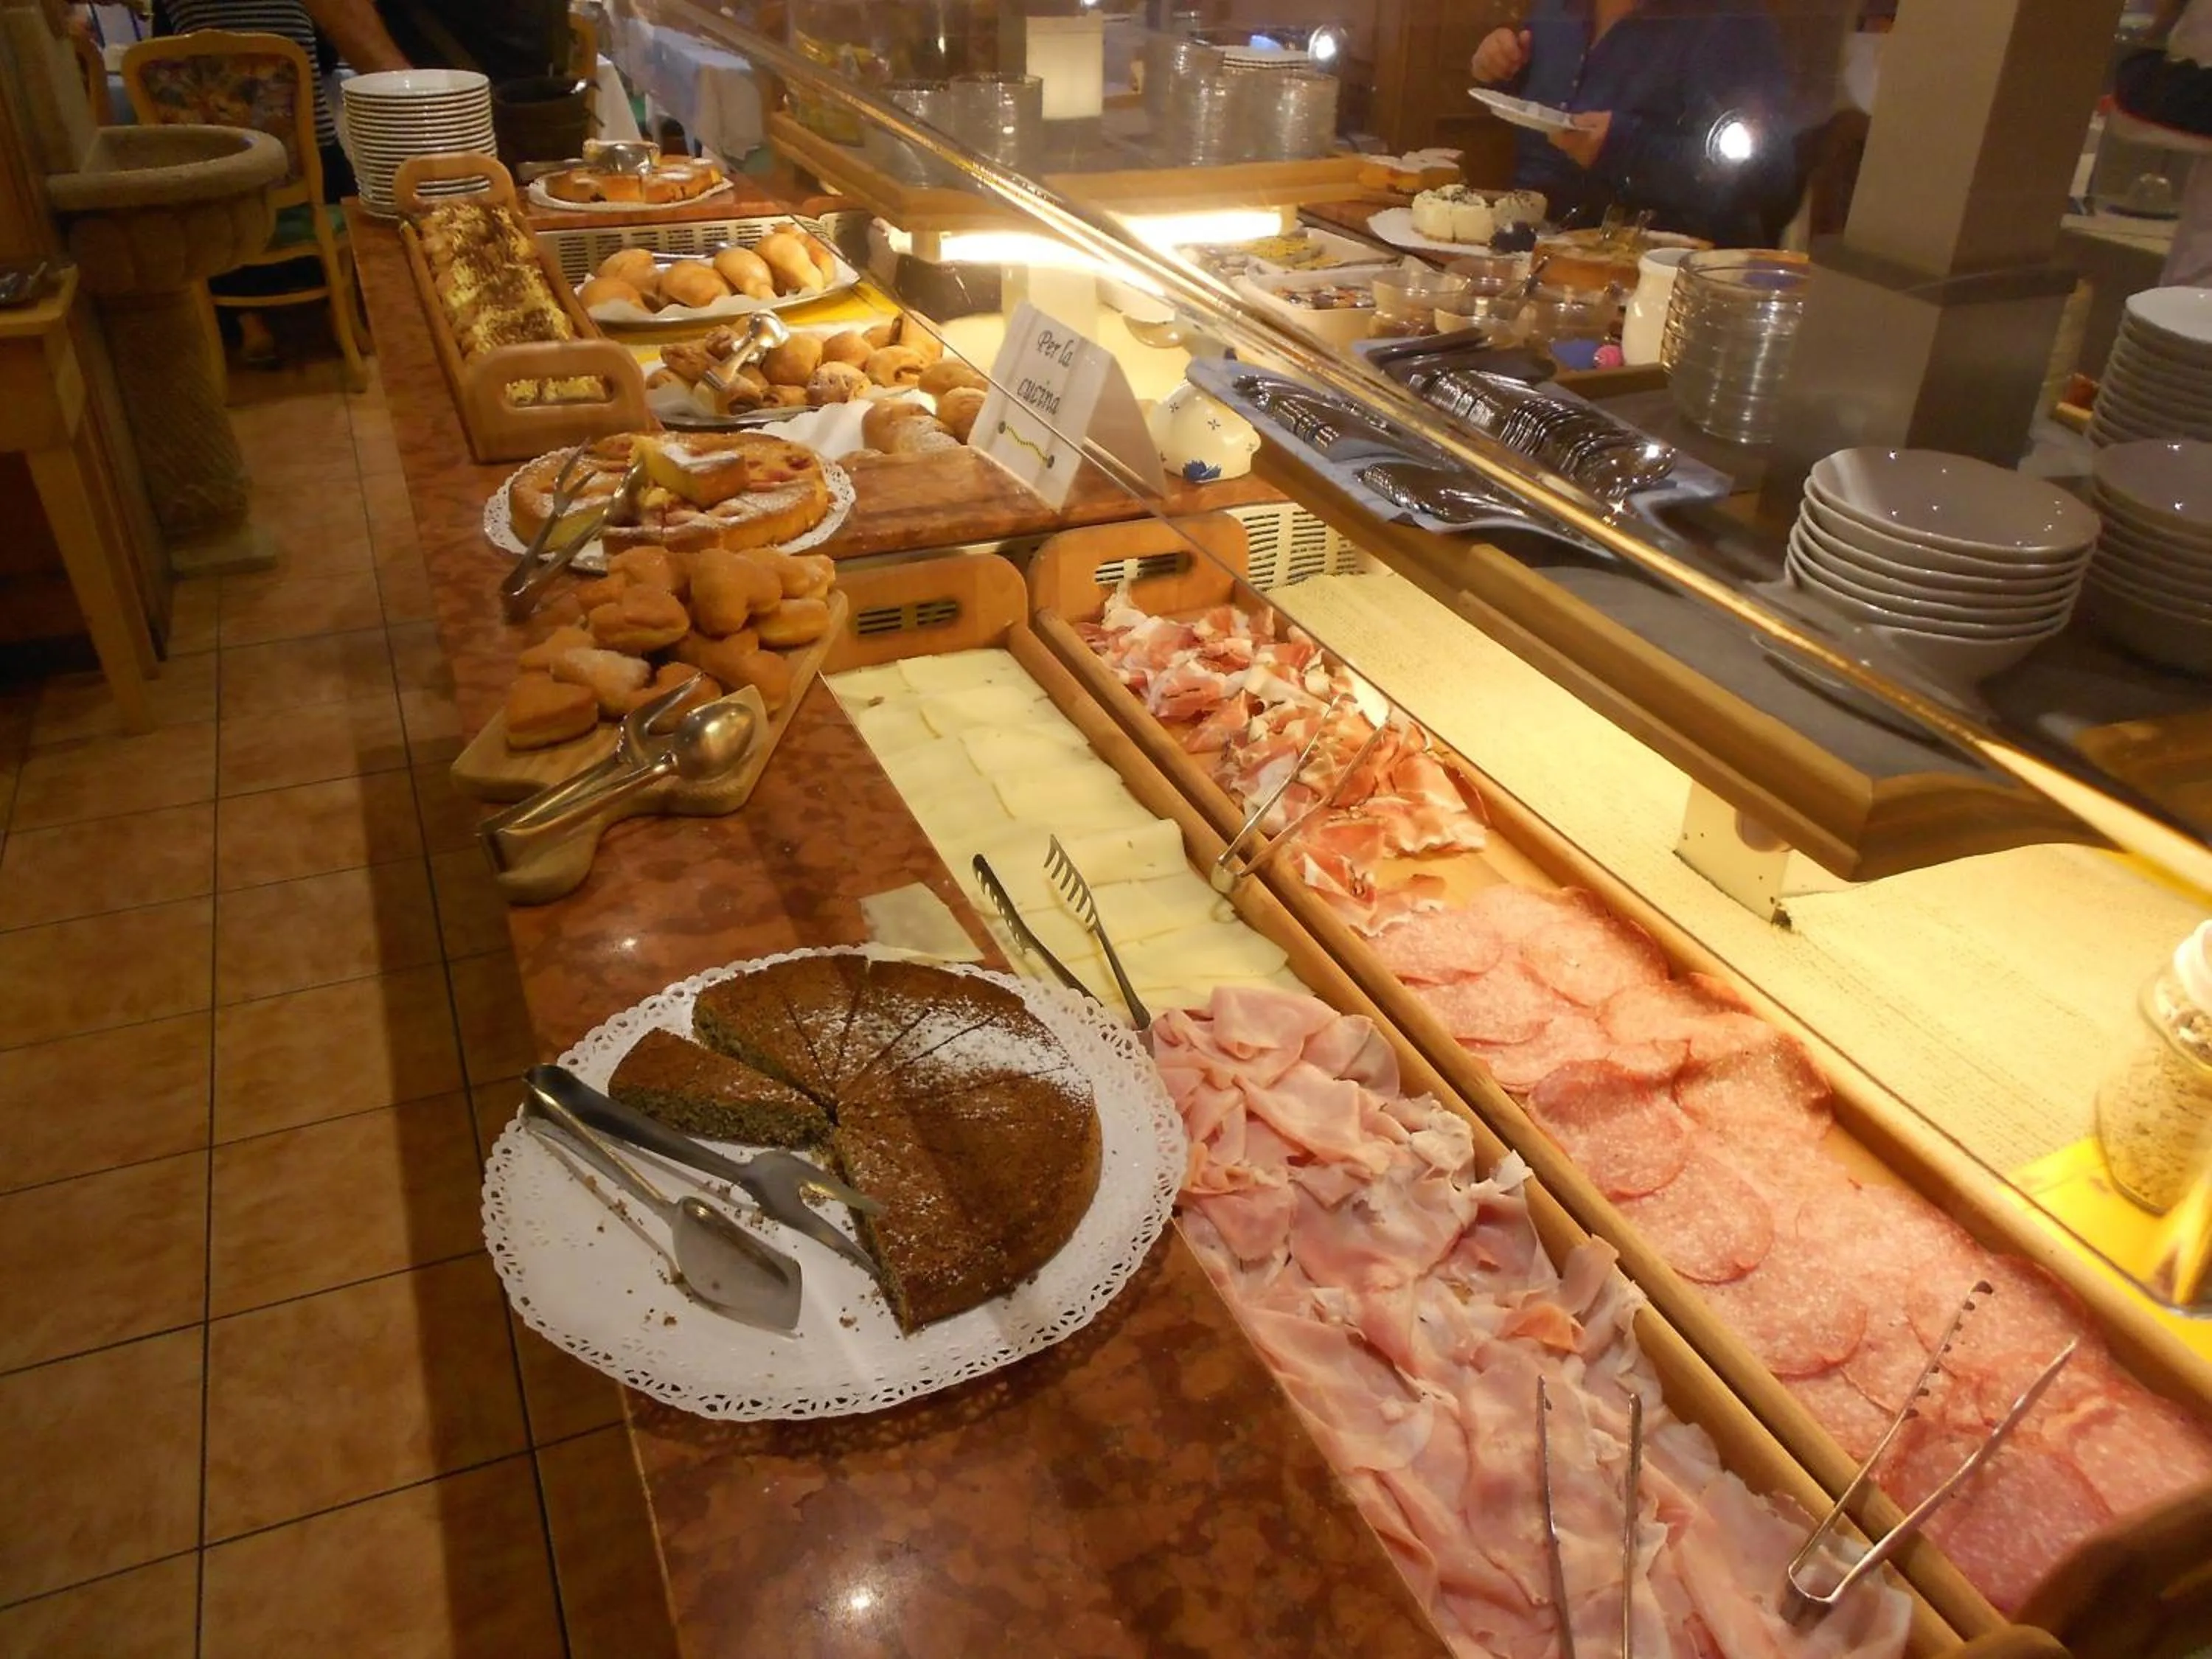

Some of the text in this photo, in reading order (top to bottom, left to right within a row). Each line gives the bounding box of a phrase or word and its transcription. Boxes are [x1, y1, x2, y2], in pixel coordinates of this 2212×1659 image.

[1037, 330, 1074, 367] Per la
[1018, 378, 1060, 414] cucina
